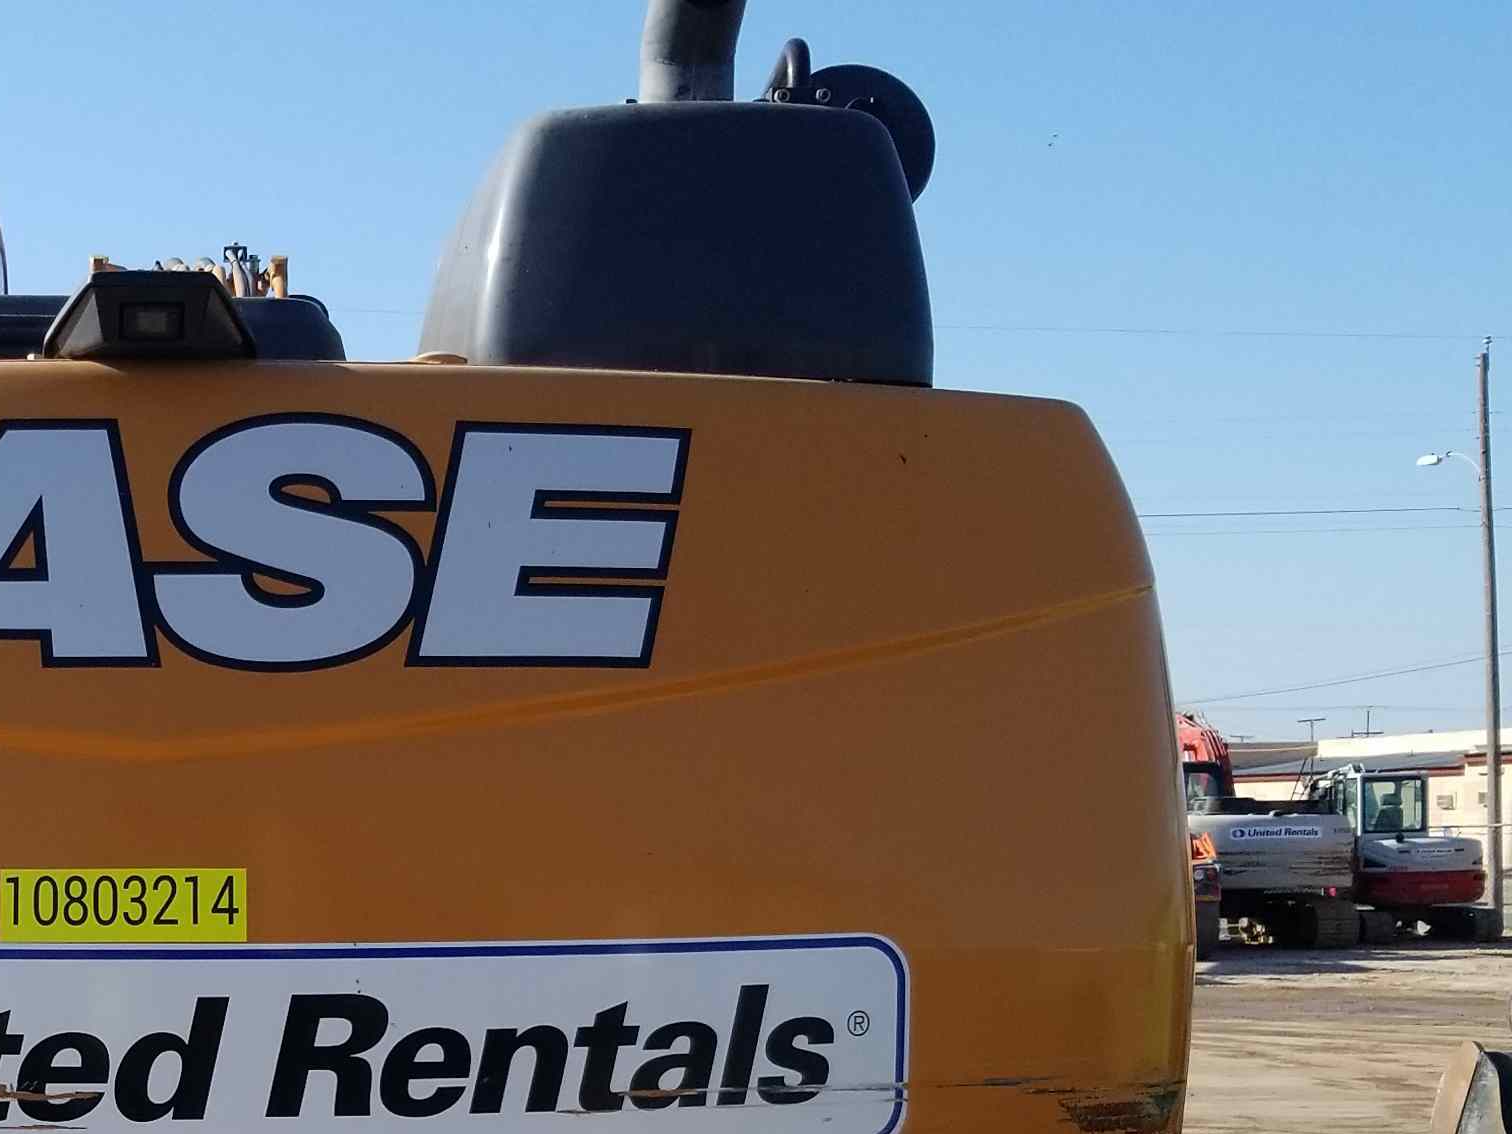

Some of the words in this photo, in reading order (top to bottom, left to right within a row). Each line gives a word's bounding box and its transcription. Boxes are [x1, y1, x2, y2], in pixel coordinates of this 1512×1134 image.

[1248, 828, 1282, 838] United
[1284, 827, 1318, 837] Rentals
[5, 875, 239, 926] 10803214
[265, 984, 834, 1118] Rentals
